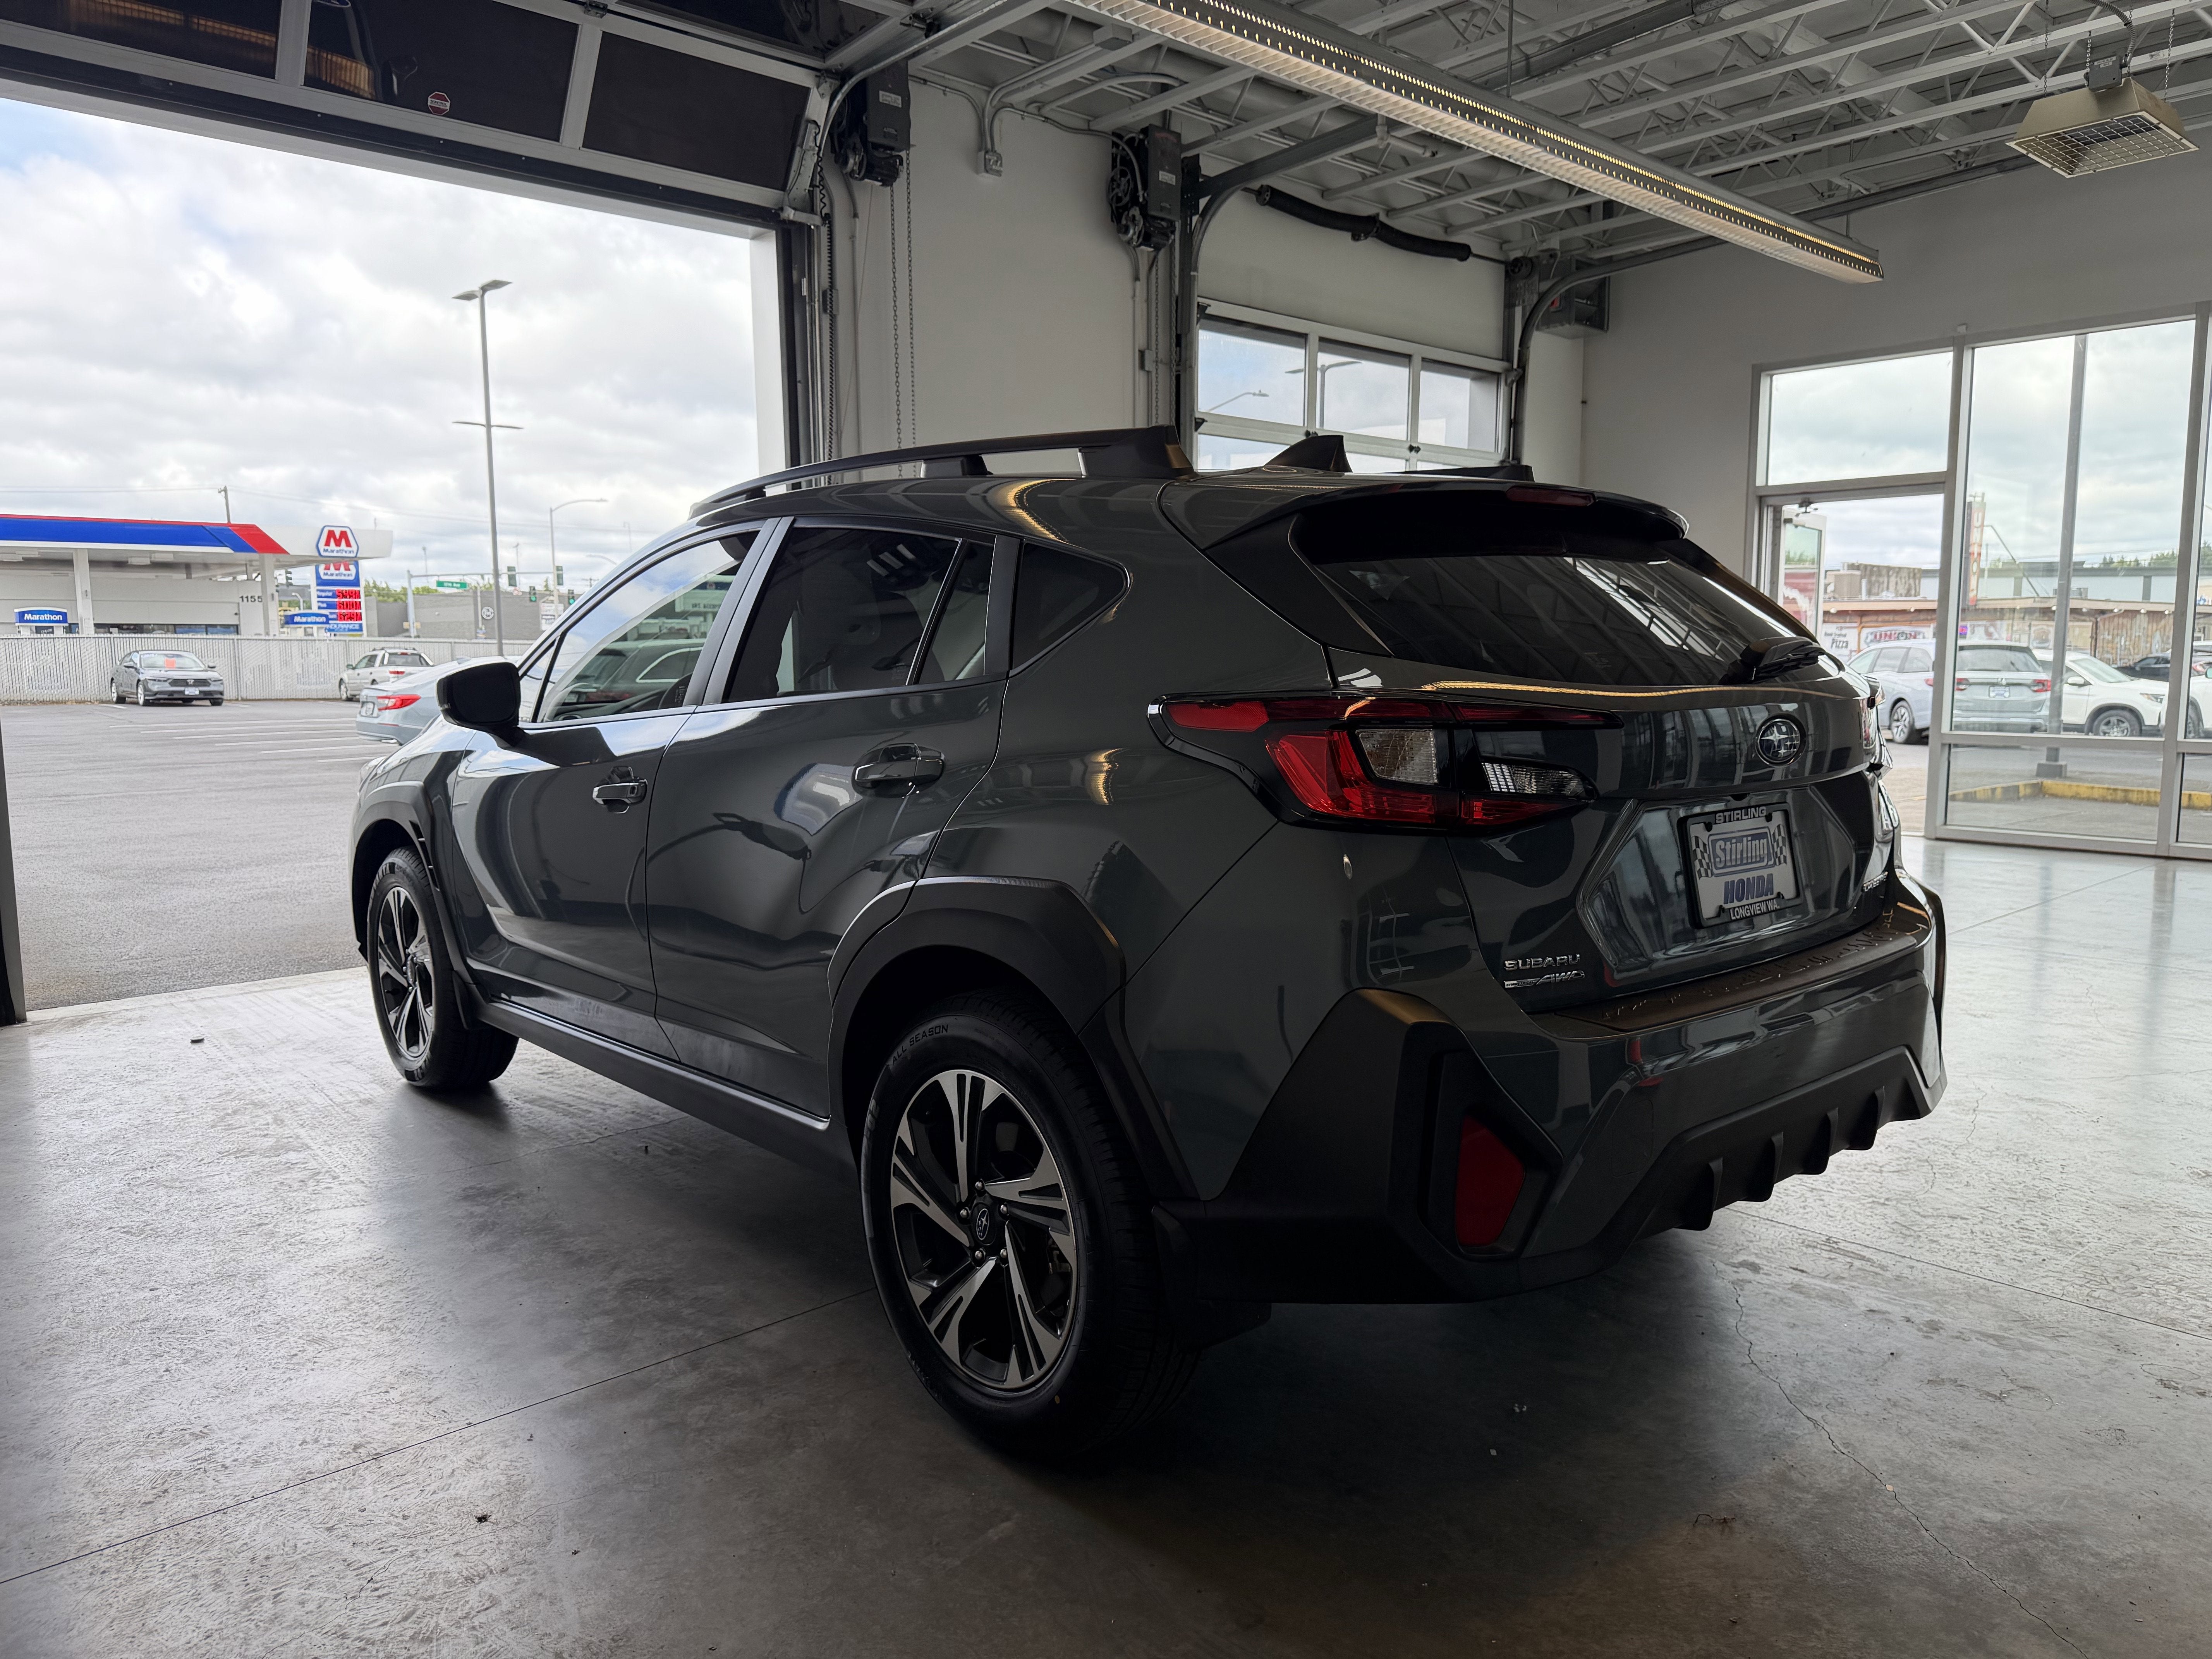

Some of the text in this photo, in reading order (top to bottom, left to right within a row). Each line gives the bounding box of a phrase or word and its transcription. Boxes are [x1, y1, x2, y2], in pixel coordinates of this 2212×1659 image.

[1831, 638, 1849, 649] Pizza
[1716, 806, 1767, 823] STIRLING
[1716, 836, 1767, 868] Stirling
[1724, 874, 1774, 904] HONDA
[1731, 902, 1765, 920] LONGVIEW
[1504, 954, 1580, 971] SUBARU
[1537, 970, 1585, 985] AWD
[892, 1024, 948, 1064] ALL SEASON
